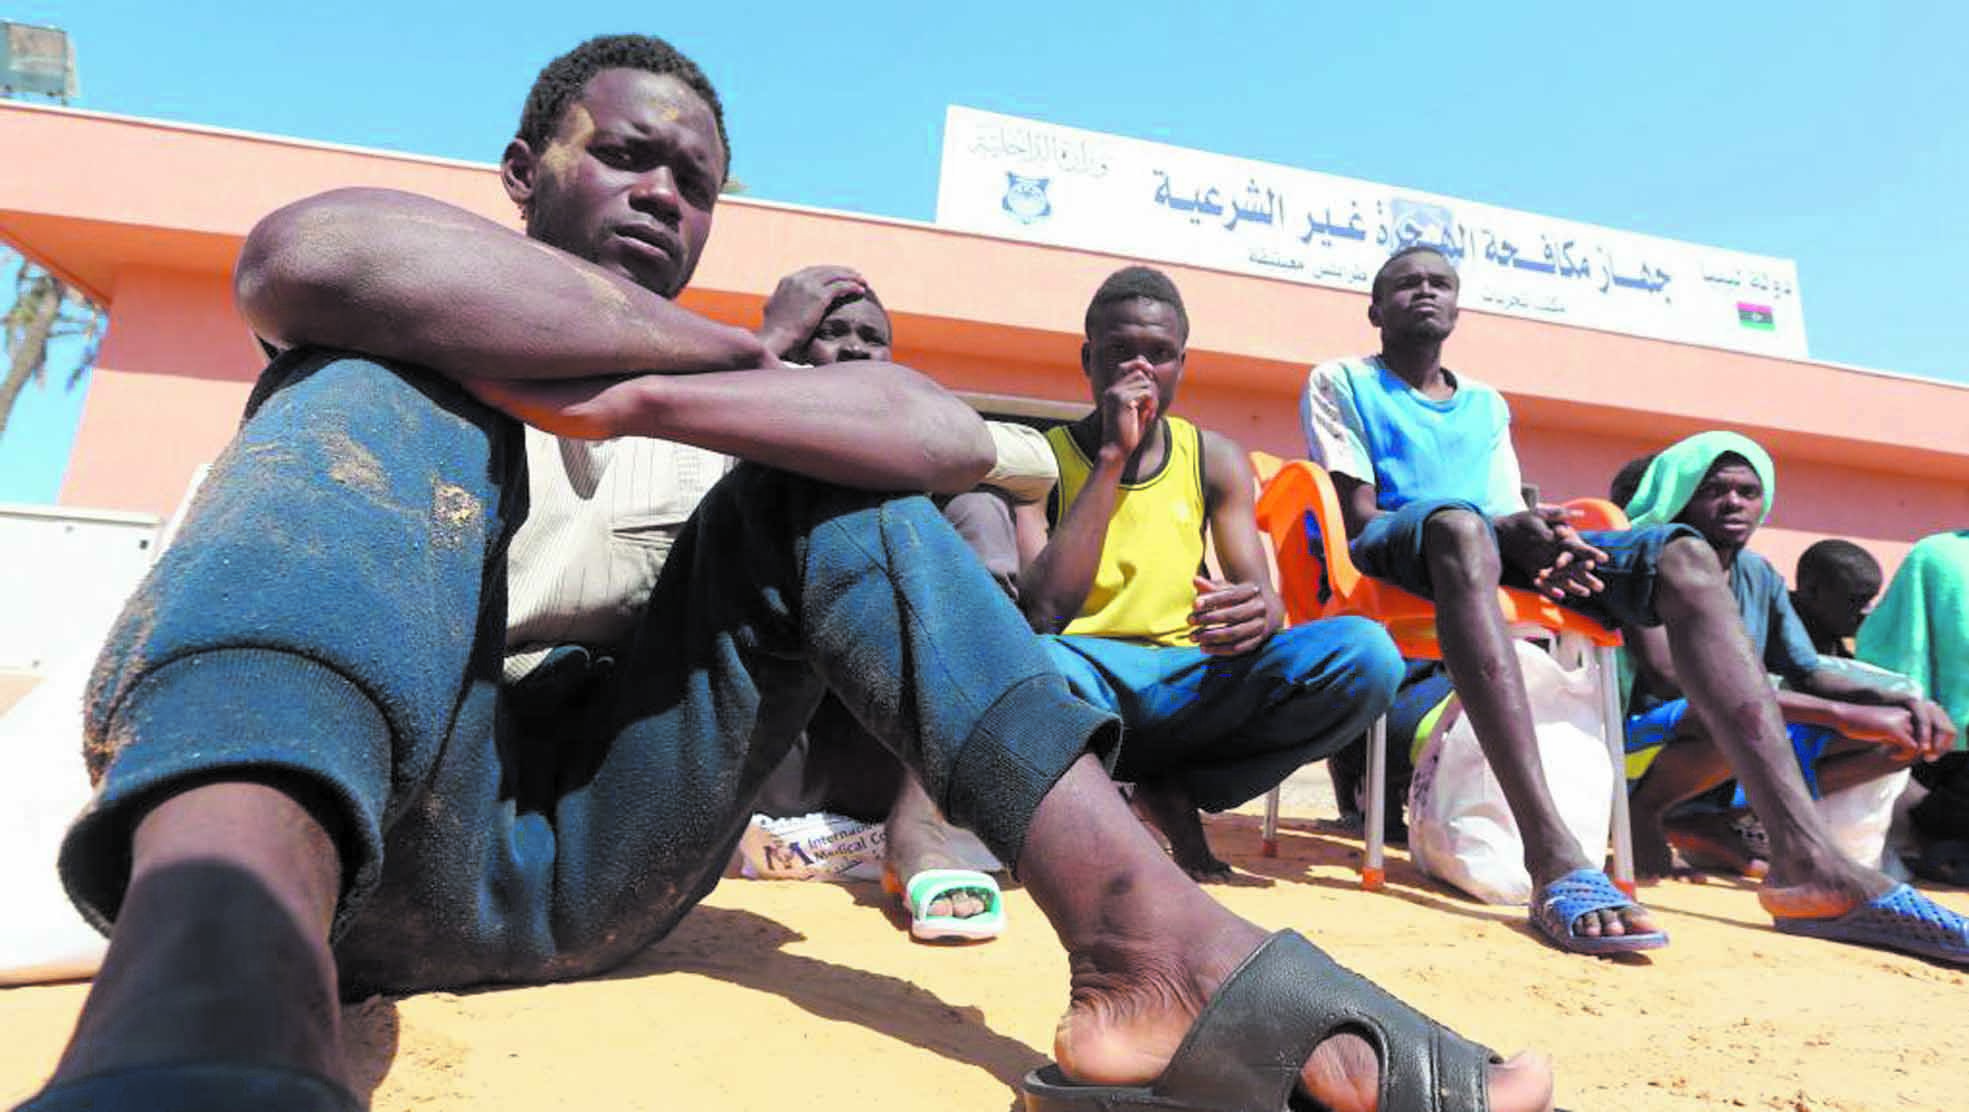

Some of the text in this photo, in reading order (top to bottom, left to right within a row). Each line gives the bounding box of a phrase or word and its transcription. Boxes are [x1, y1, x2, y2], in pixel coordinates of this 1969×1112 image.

[1153, 168, 1285, 231] الشرعية
[1301, 201, 1367, 246] غير
[1481, 228, 1590, 279] مكافحة
[1596, 245, 1672, 304] جهاز
[814, 831, 888, 860] Medical Co
